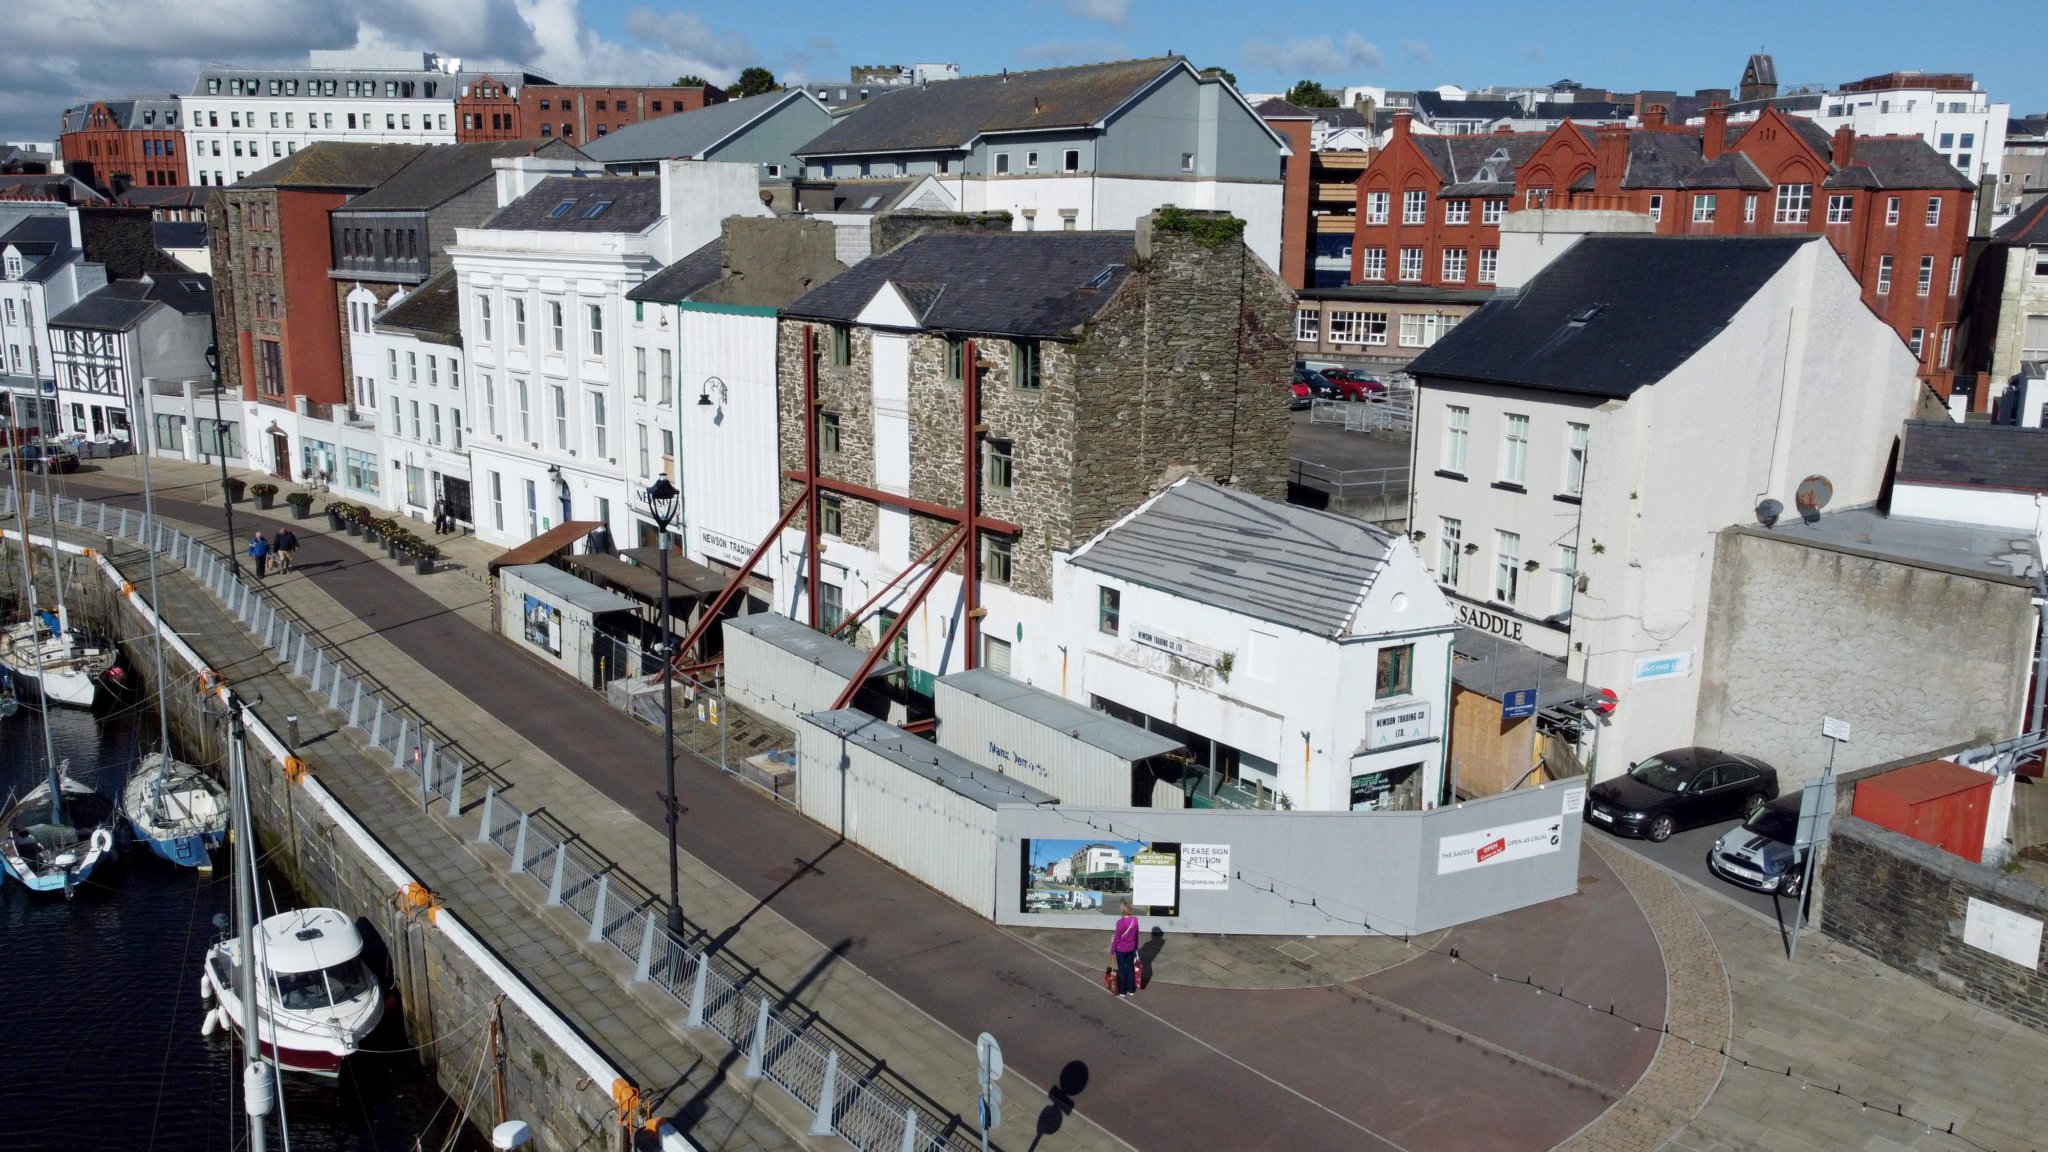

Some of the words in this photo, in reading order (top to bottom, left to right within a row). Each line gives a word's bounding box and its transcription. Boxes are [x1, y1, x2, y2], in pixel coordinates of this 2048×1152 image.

[702, 532, 727, 549] NEWSON
[729, 541, 755, 557] TRADING
[1460, 605, 1523, 641] SADDLE
[1138, 631, 1153, 642] NEWSON
[1154, 636, 1168, 647] TRADING
[1376, 716, 1396, 727] NEWSON
[1397, 712, 1417, 724] TRADING
[1507, 839, 1523, 847] OPEN
[1530, 834, 1547, 842] USUAL
[1182, 847, 1209, 855] PLEASE
[1453, 848, 1475, 858] SADDLE
[1483, 843, 1498, 853] OPEN
[1189, 856, 1221, 864] PETITION
